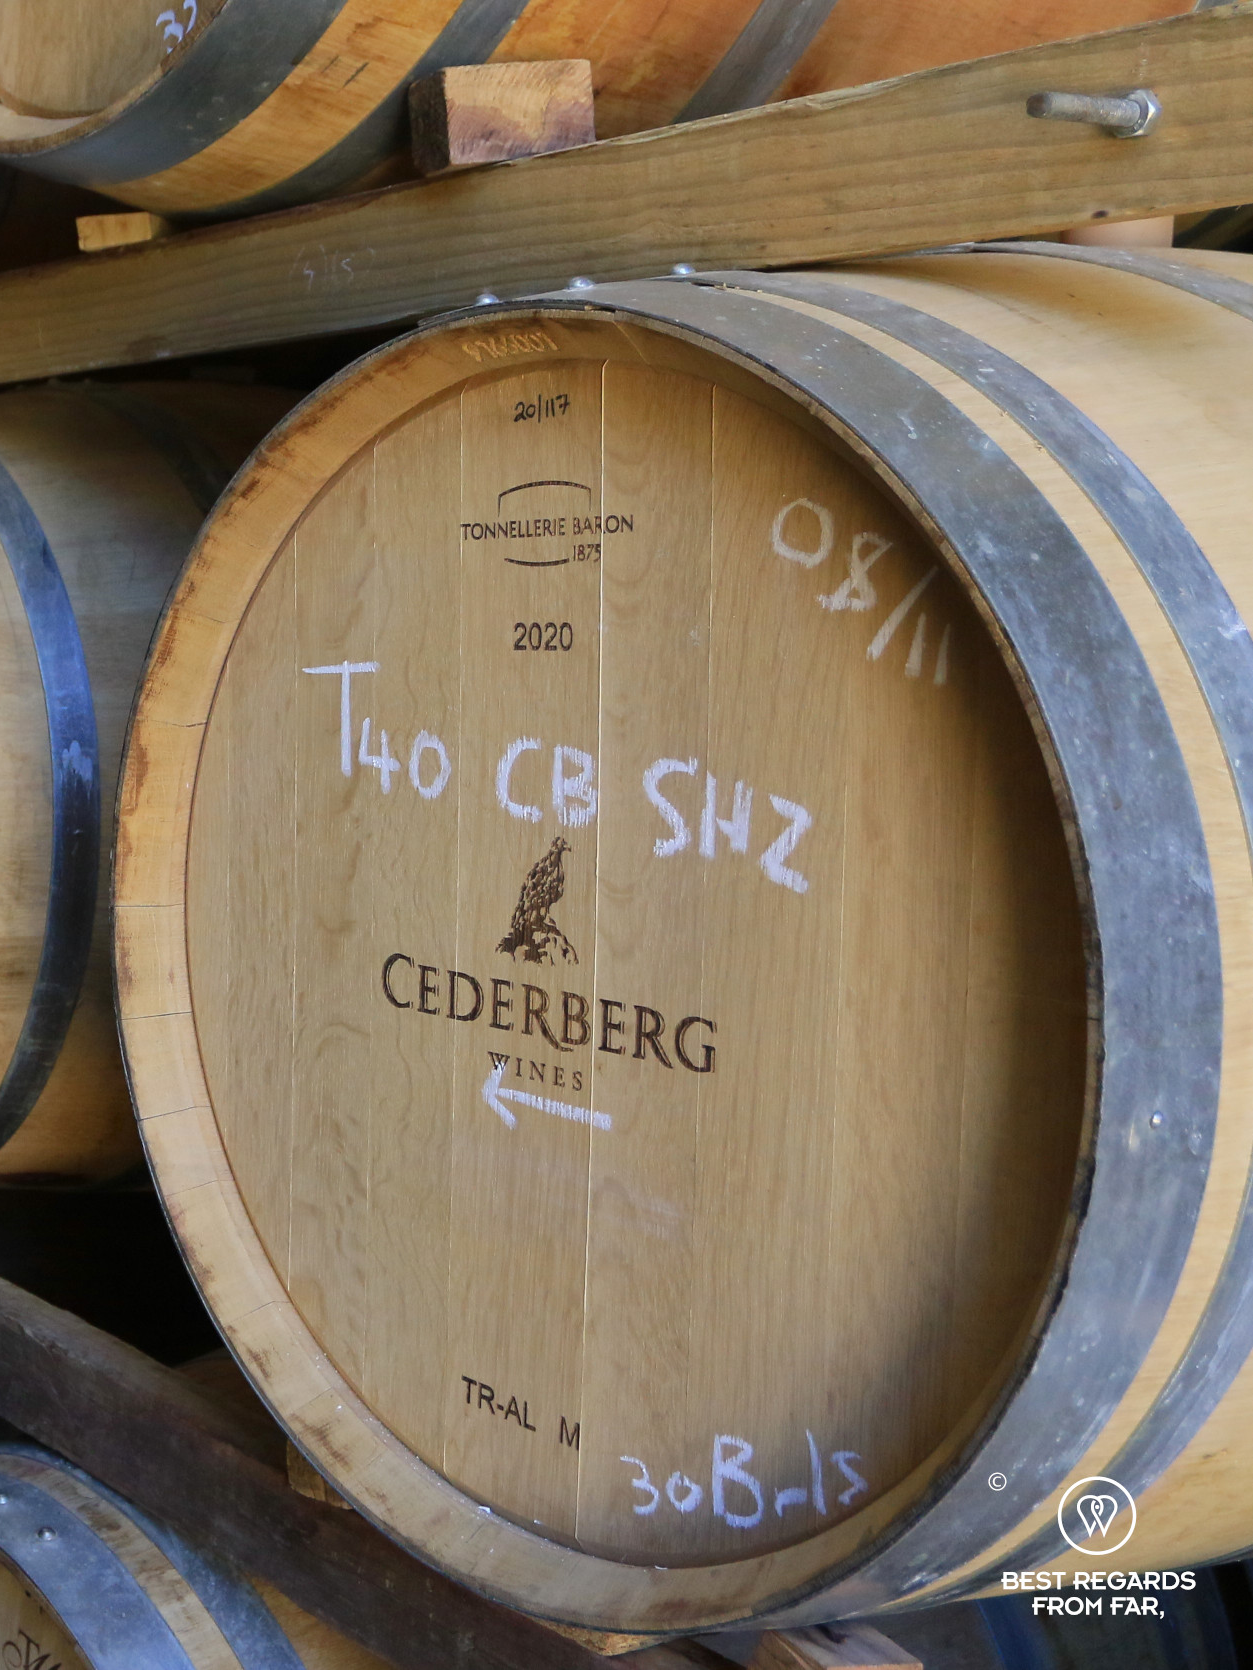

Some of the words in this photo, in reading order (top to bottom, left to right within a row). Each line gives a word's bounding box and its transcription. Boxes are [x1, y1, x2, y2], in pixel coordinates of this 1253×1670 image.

[513, 394, 571, 424] 20/117
[460, 517, 566, 541] TONNELLERIE
[572, 514, 634, 536] BARON
[572, 543, 602, 563] 1875
[513, 621, 574, 652] 2020
[495, 735, 599, 829] CB
[381, 952, 718, 1074] CEDERBERG
[487, 1049, 584, 1092] WINES
[461, 1374, 537, 1432] TR-AL
[558, 1415, 581, 1451] M
